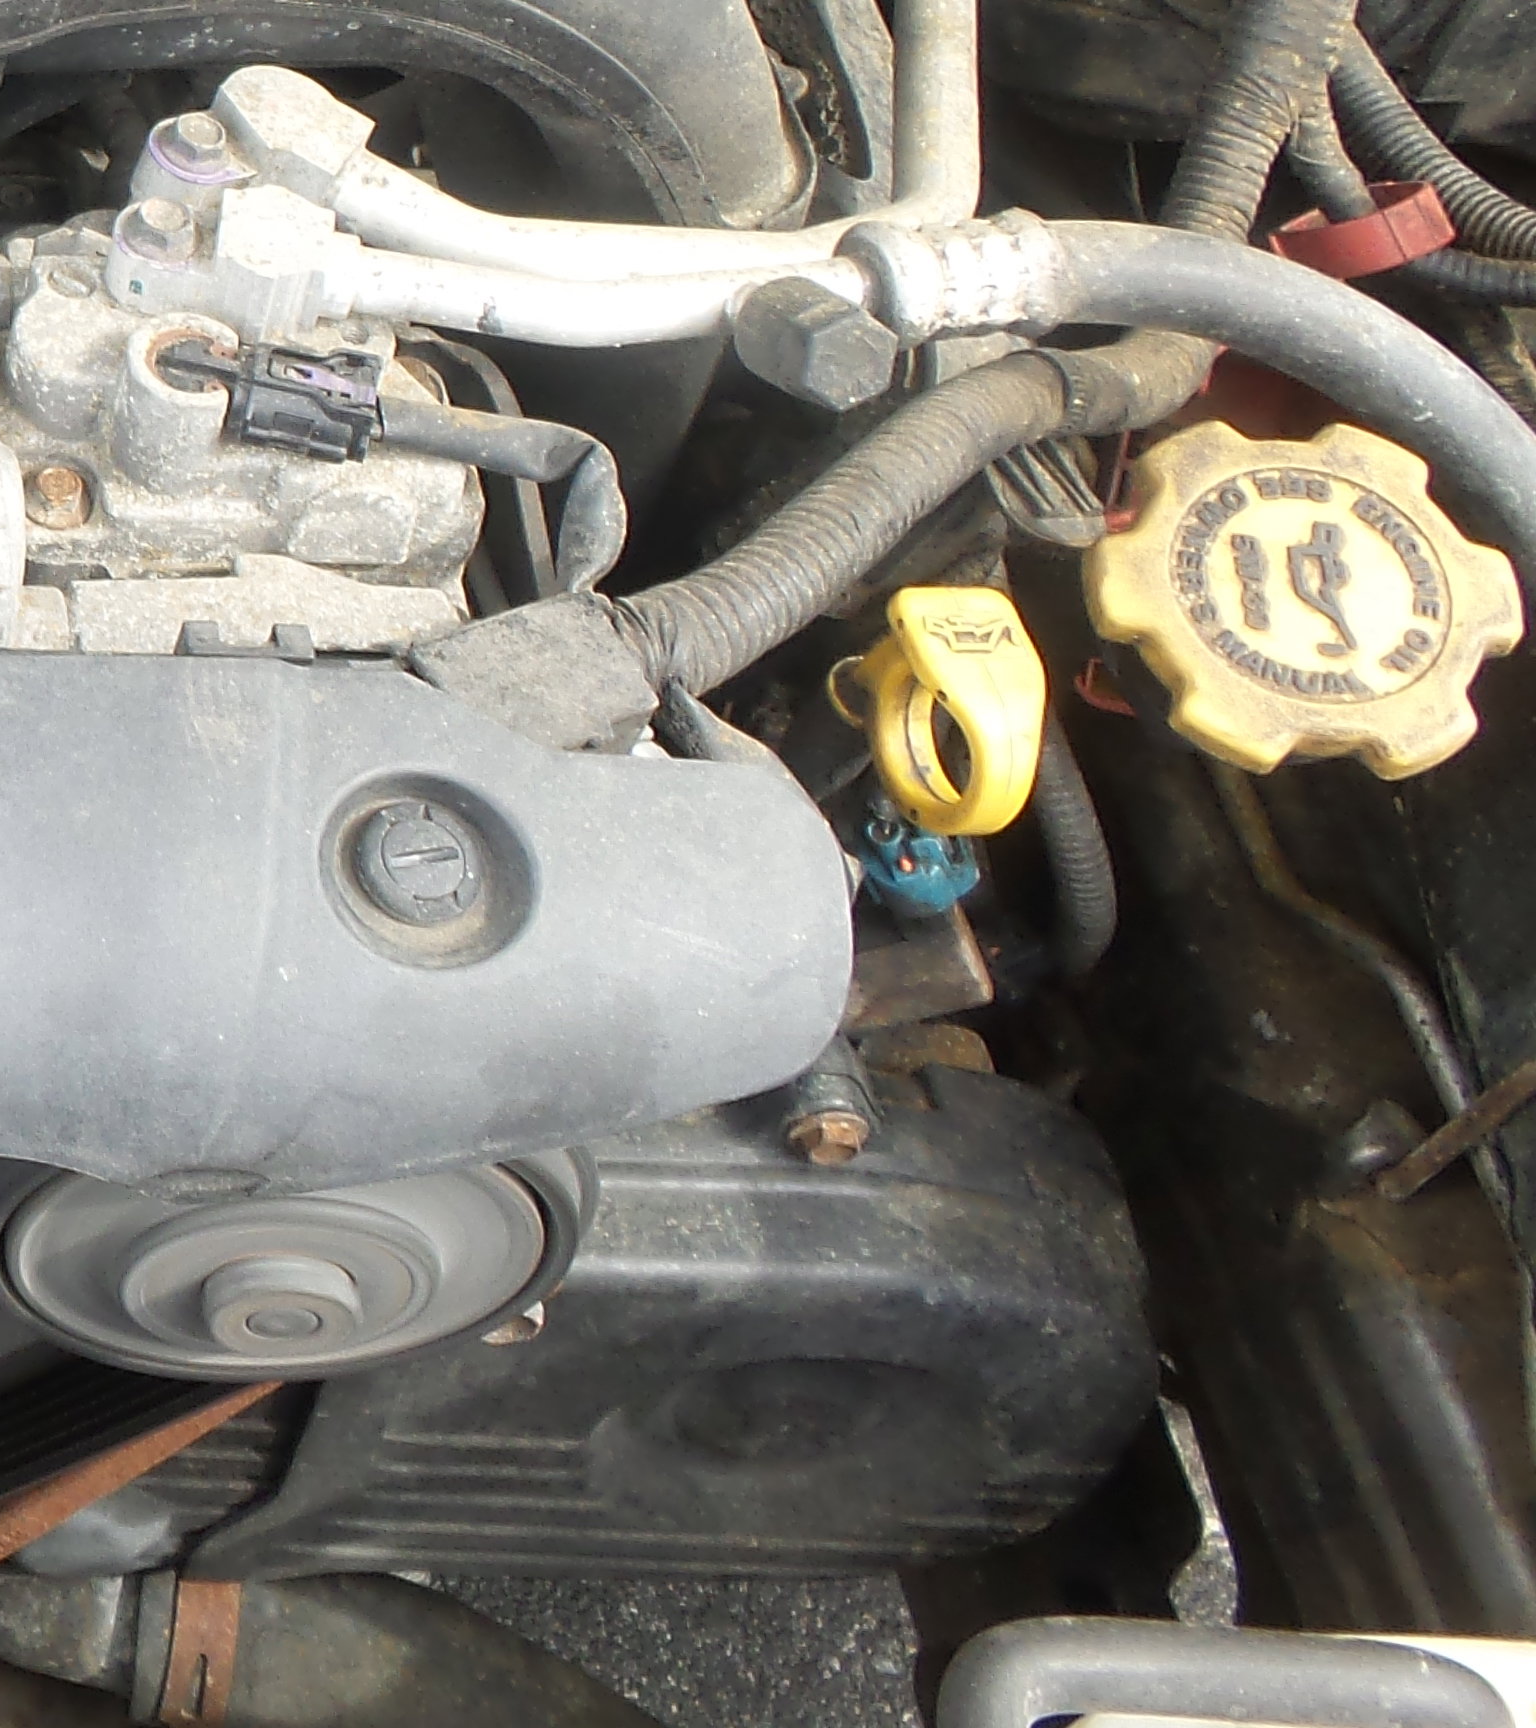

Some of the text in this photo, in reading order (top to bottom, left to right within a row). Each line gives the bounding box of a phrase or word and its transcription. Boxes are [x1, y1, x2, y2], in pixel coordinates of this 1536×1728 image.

[1253, 474, 1333, 503] SEE
[1352, 495, 1441, 673] ENGINE OIL
[1212, 630, 1375, 694] MANUAL
